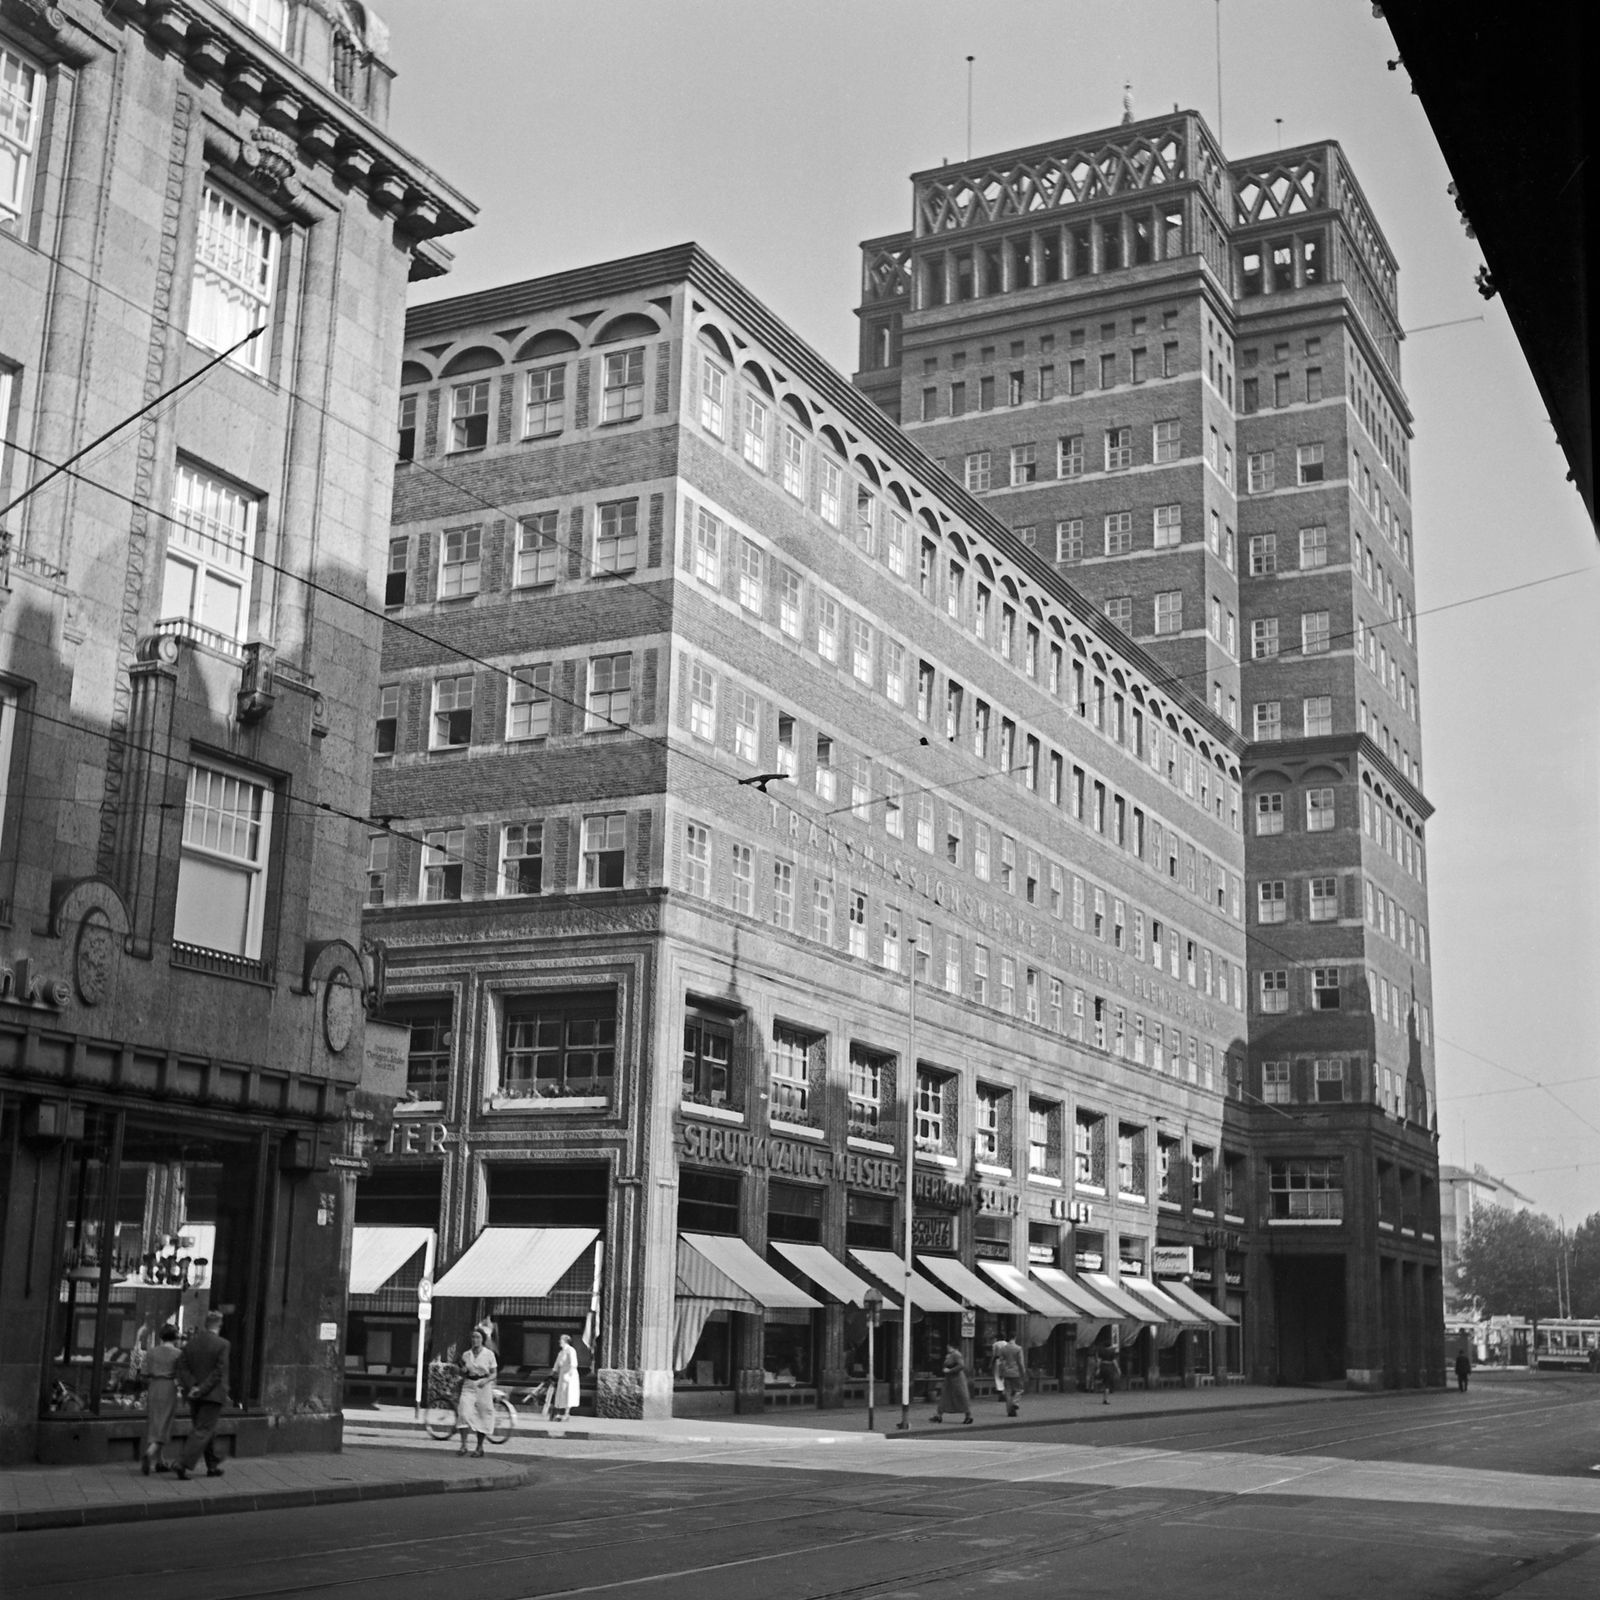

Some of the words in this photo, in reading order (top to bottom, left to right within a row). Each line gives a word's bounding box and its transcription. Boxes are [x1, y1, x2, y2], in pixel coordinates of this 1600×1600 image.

[683, 1124, 815, 1176] STRUNKMANN
[833, 1152, 900, 1190] MEISTER
[913, 1234, 948, 1245] PAPIER
